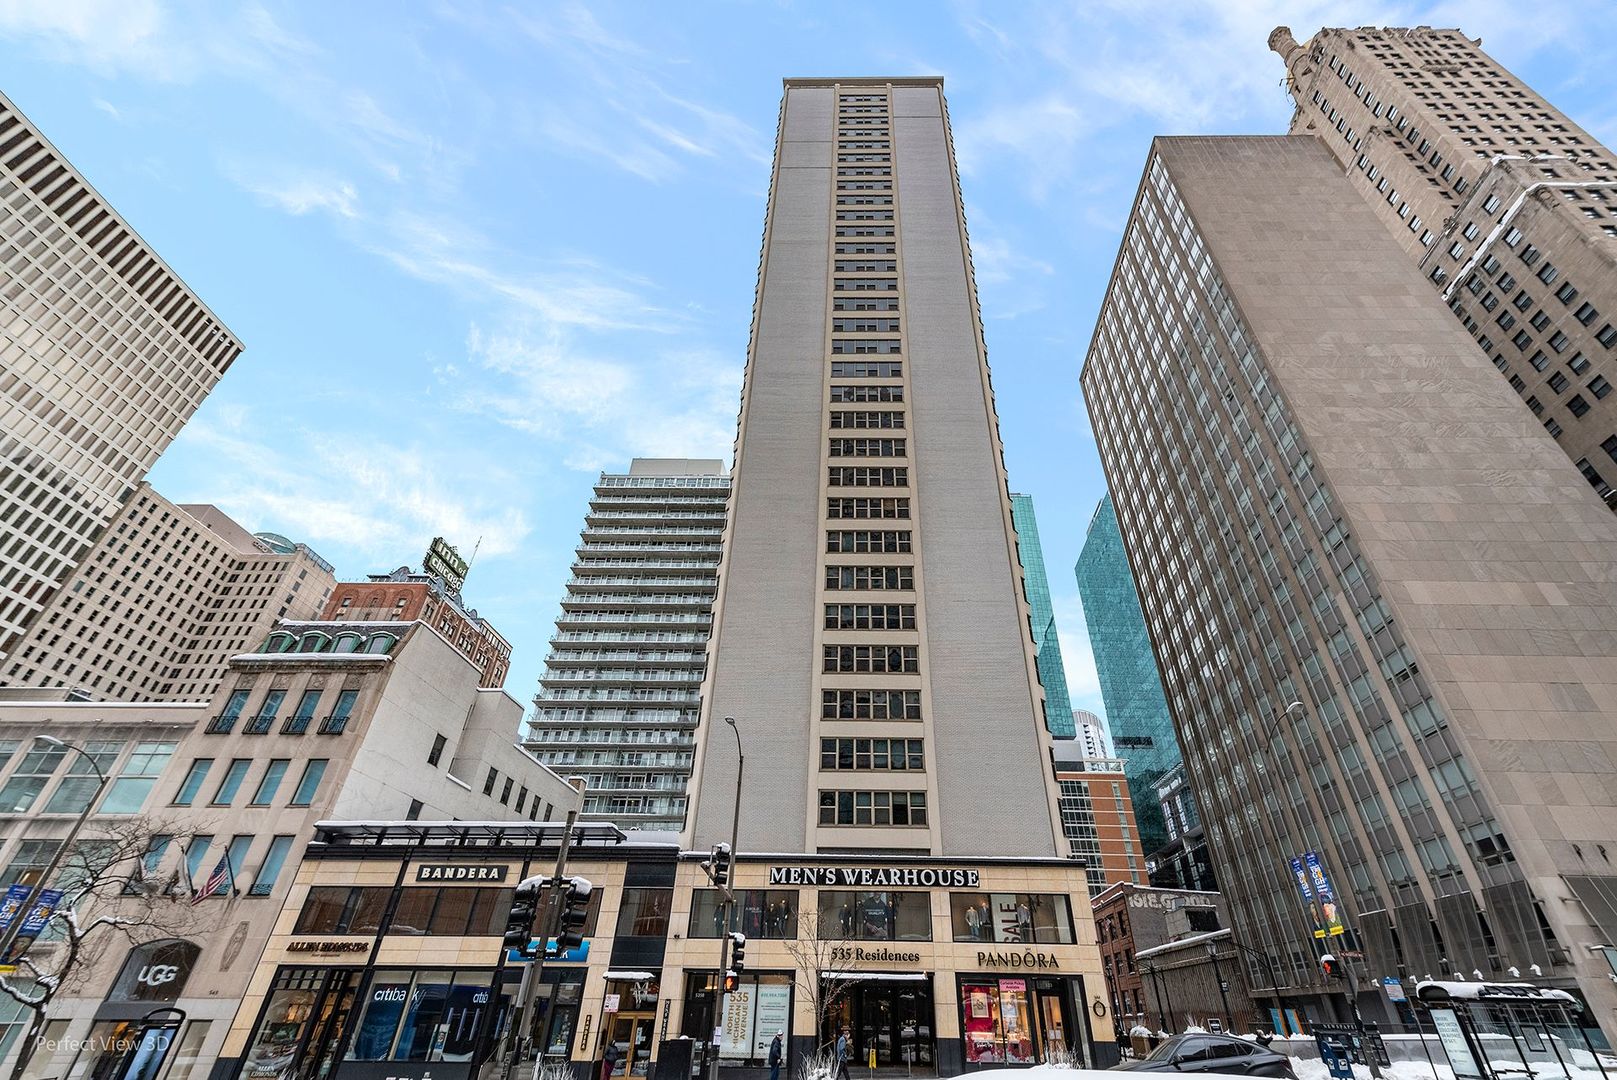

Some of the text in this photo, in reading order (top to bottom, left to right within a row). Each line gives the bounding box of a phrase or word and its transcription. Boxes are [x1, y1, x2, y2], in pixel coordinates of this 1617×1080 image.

[420, 867, 500, 880] BANDERA
[769, 866, 979, 888] MEN'S WEARHOUSE
[1000, 902, 1018, 943] SALE
[286, 942, 369, 952] ALLEN EDMONDS
[830, 948, 920, 962] 535 Residences
[138, 964, 179, 986] UGG
[374, 987, 420, 1000] citibak
[729, 992, 749, 1002] 535
[726, 1004, 735, 1034] NORTH
[732, 1004, 741, 1048] MICHIGAN
[740, 1005, 748, 1040] AVENUE
